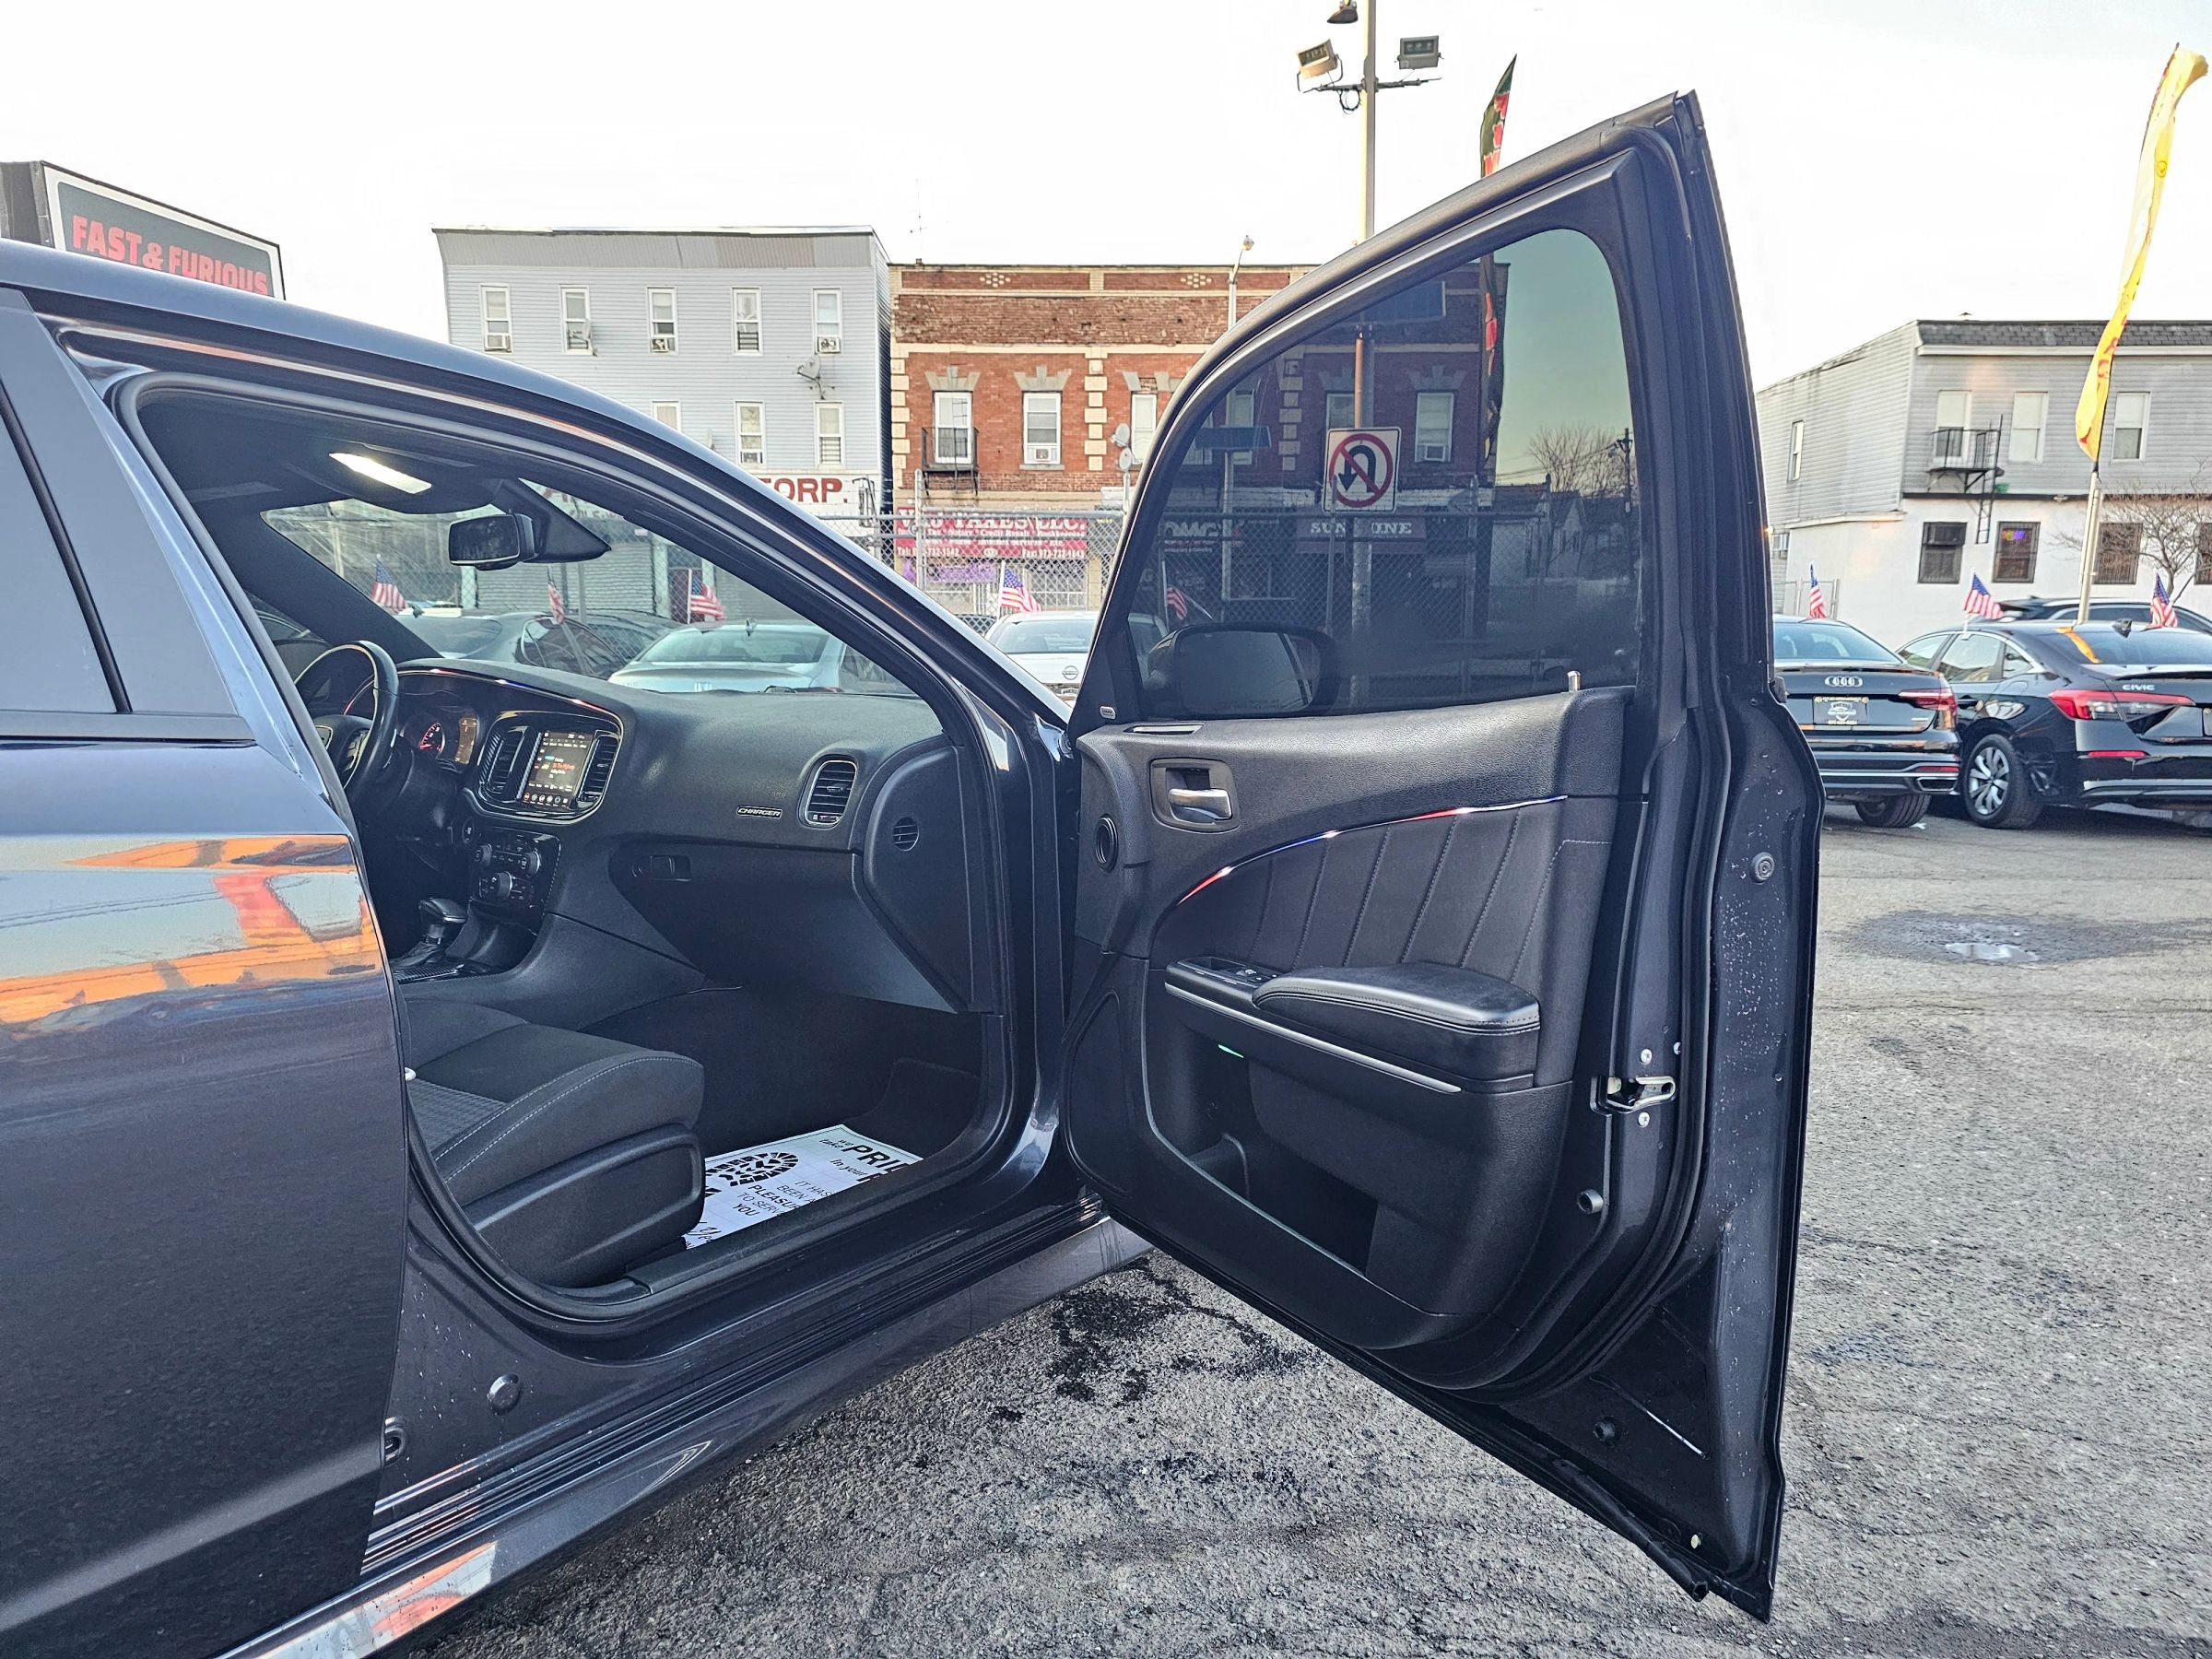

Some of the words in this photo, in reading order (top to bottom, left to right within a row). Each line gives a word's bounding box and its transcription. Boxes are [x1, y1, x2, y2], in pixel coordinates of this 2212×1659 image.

[72, 214, 142, 265] FAST
[142, 241, 163, 271] &
[169, 244, 268, 295] FURIOUS
[759, 477, 848, 503] ORP.
[1310, 522, 1413, 535] SUNINE
[738, 807, 781, 817] CHARGER
[737, 1192, 755, 1202] TO
[747, 1184, 801, 1209] PLEASUR
[776, 1184, 808, 1200] BEEN
[733, 1204, 759, 1217] YOU
